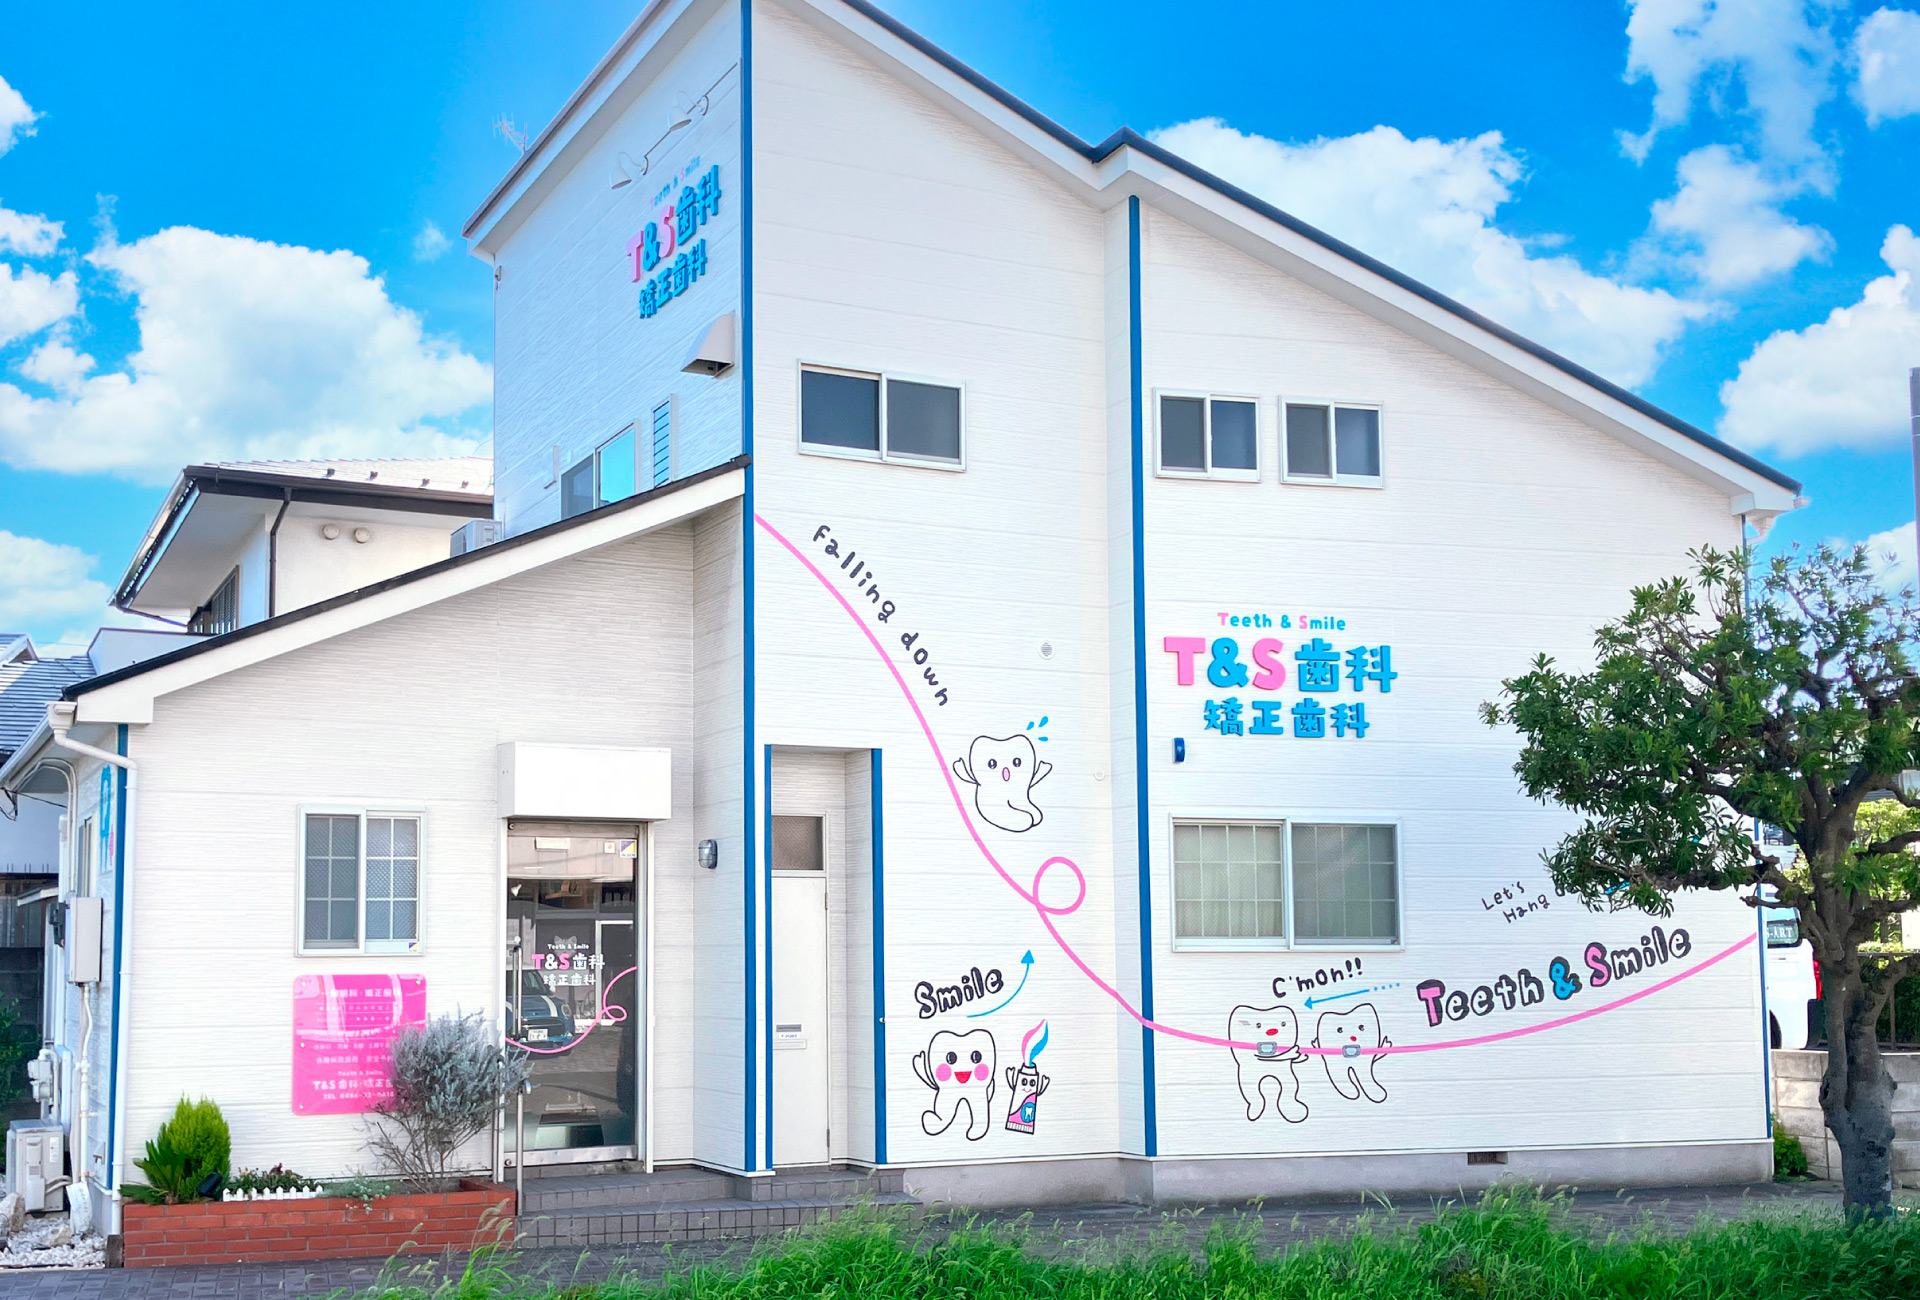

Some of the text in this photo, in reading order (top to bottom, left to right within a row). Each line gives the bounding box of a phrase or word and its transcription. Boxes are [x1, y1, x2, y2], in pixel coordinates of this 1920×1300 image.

[639, 238, 708, 319] 矯正歯科
[1217, 612, 1346, 631] Teeth & Smile
[901, 632, 948, 706] down
[1164, 636, 1398, 693] T&S歯科
[1204, 697, 1370, 738] 矯正歯科
[1481, 881, 1525, 911] Let's
[1503, 894, 1551, 923] Hang
[532, 952, 605, 970] T&S歯科
[544, 973, 596, 986] 矯正歯科
[1416, 926, 1691, 1027] Teeth & Smile
[914, 966, 1004, 1019] Smile
